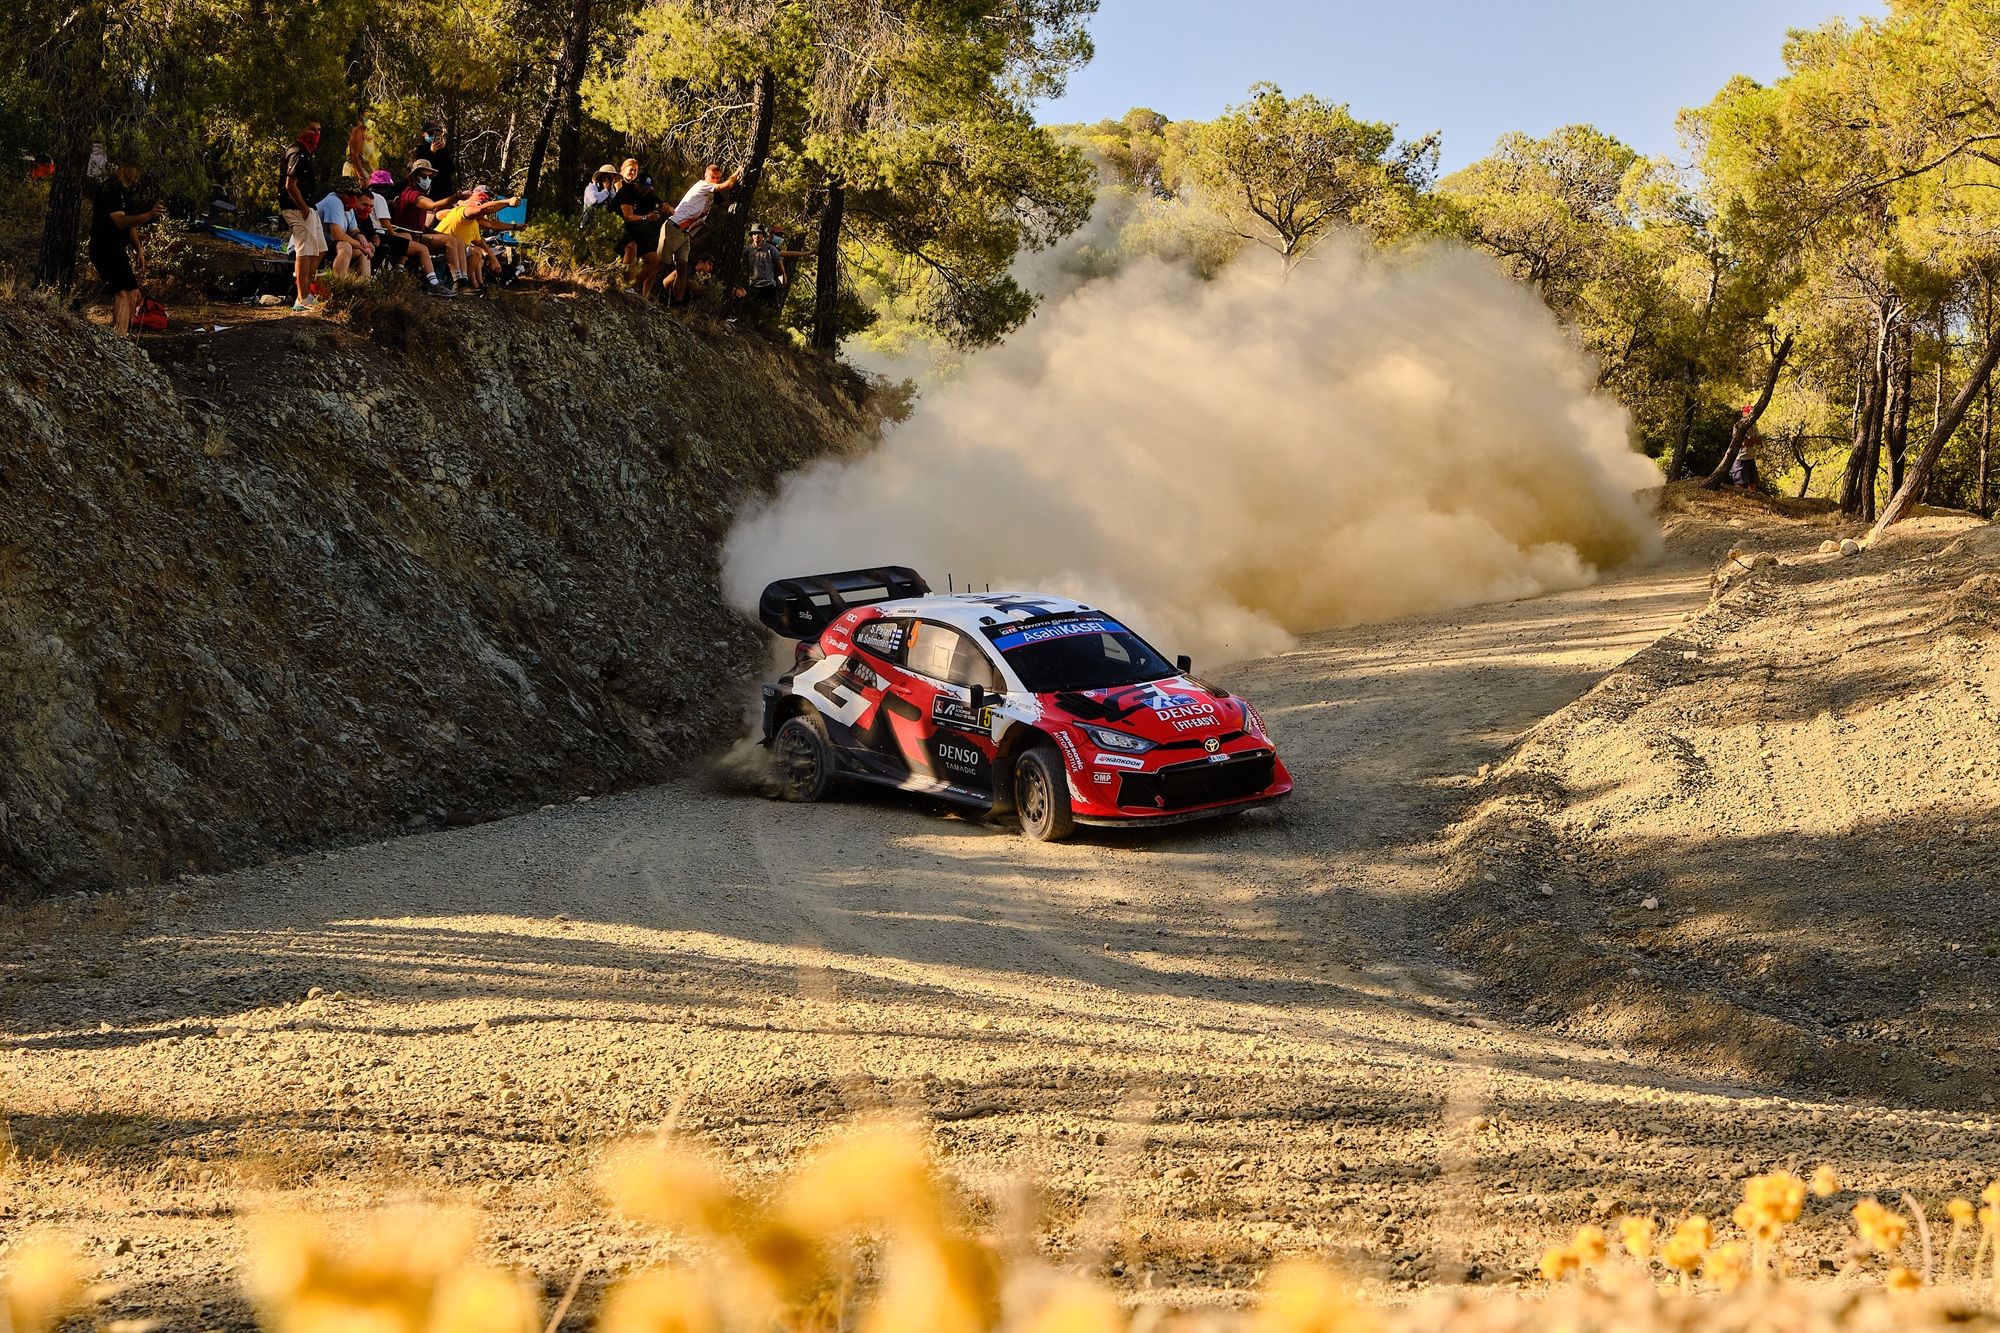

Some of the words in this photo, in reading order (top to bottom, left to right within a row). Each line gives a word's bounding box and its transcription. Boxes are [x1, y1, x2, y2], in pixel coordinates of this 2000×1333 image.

[907, 620, 923, 648] 5
[983, 707, 993, 728] 5
[1156, 703, 1215, 721] DENSO
[939, 743, 979, 765] DENSO
[1052, 731, 1079, 773] AUTOMOTIVE
[1059, 730, 1084, 771] Panasonic
[945, 761, 977, 776] TAMADIC
[1093, 773, 1112, 782] OMP
